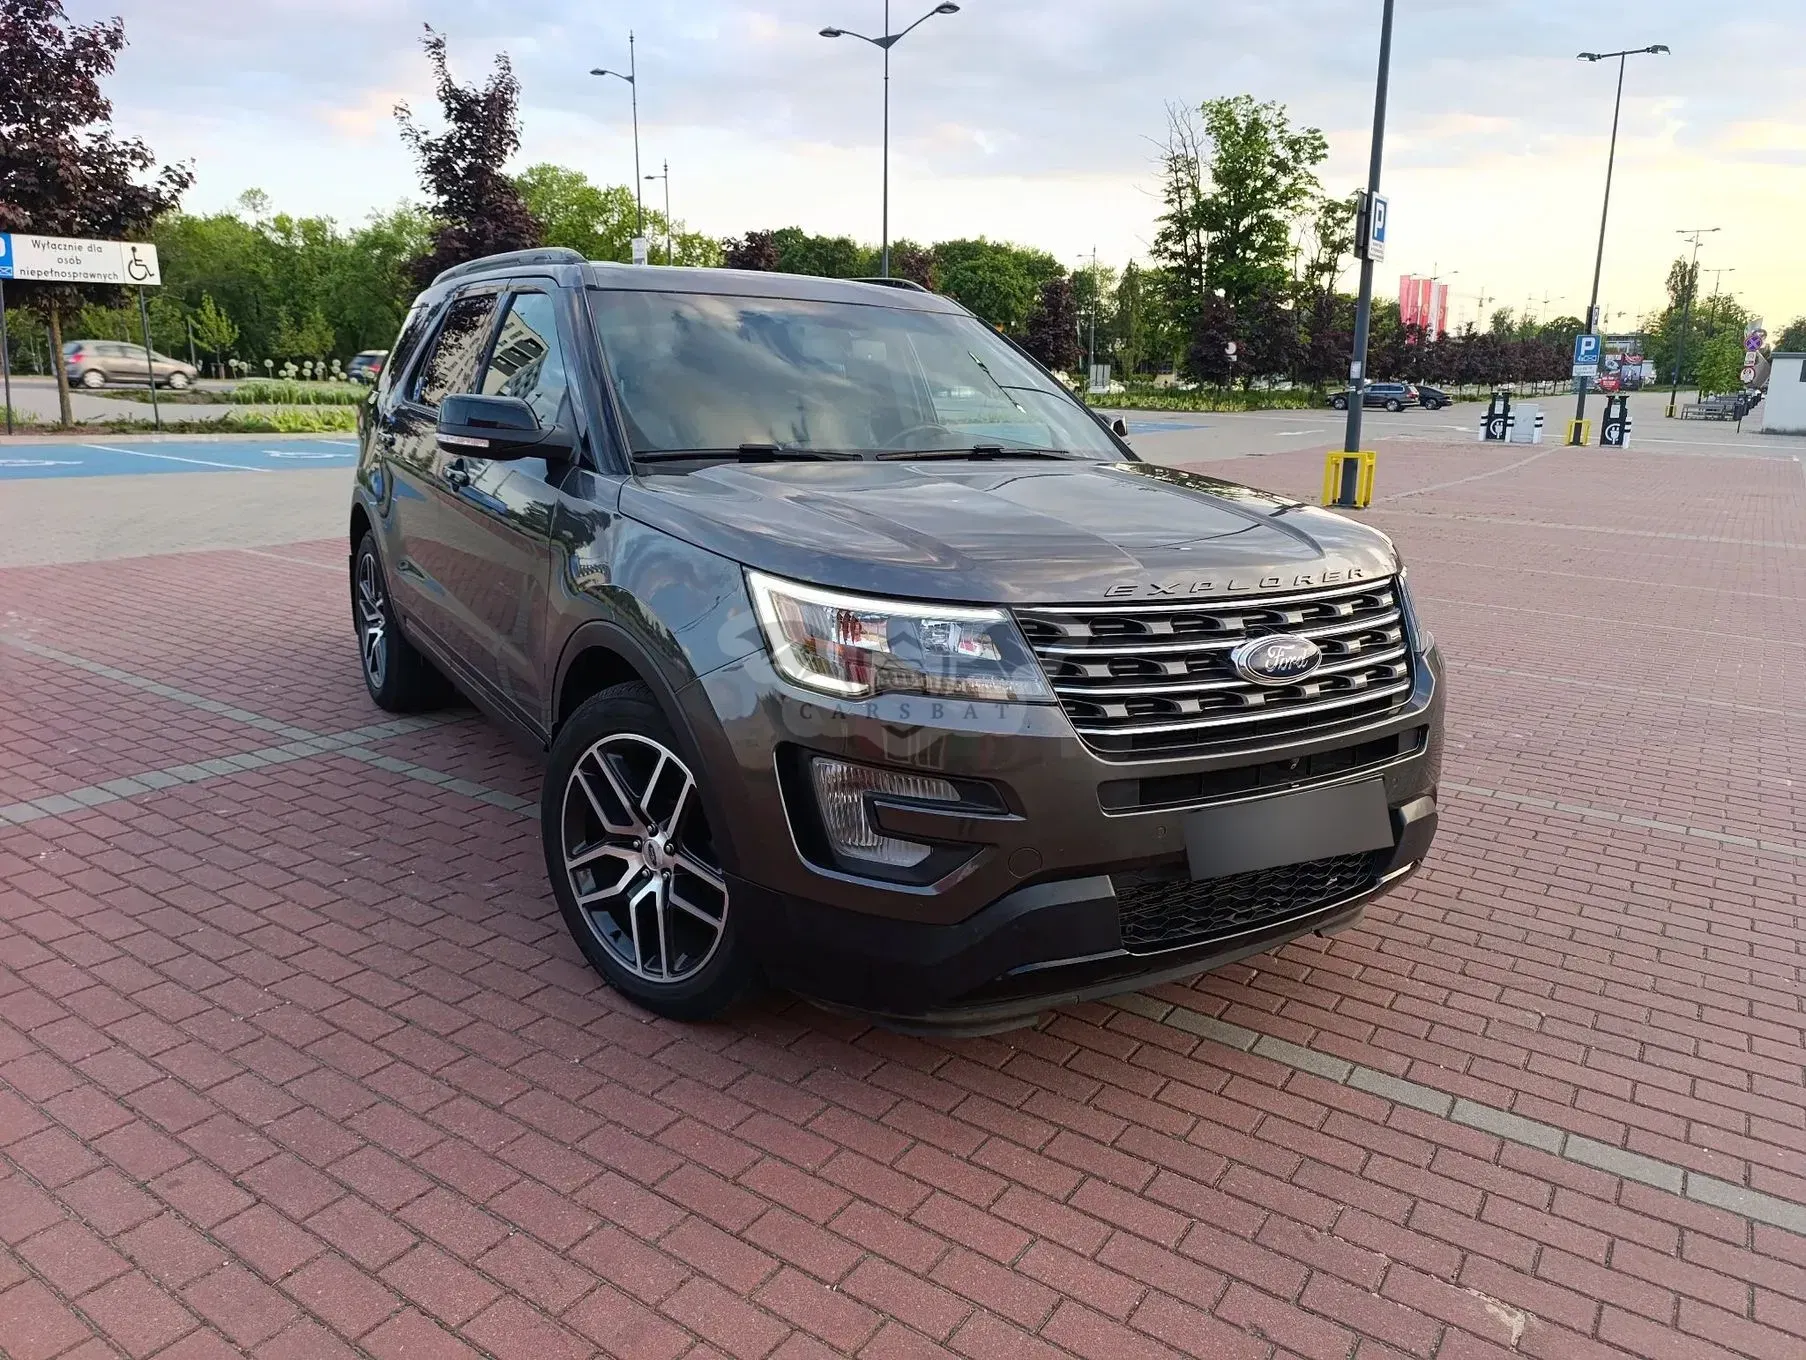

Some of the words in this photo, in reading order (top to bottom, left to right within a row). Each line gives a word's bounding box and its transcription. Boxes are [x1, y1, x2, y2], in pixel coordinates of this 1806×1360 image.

[1374, 201, 1385, 238] P
[87, 243, 103, 253] dla
[57, 255, 82, 265] osób
[20, 266, 119, 281] niepełnosprawnych
[1580, 337, 1596, 356] P
[1104, 568, 1364, 598] EXPLORER
[1264, 645, 1310, 672] Ford
